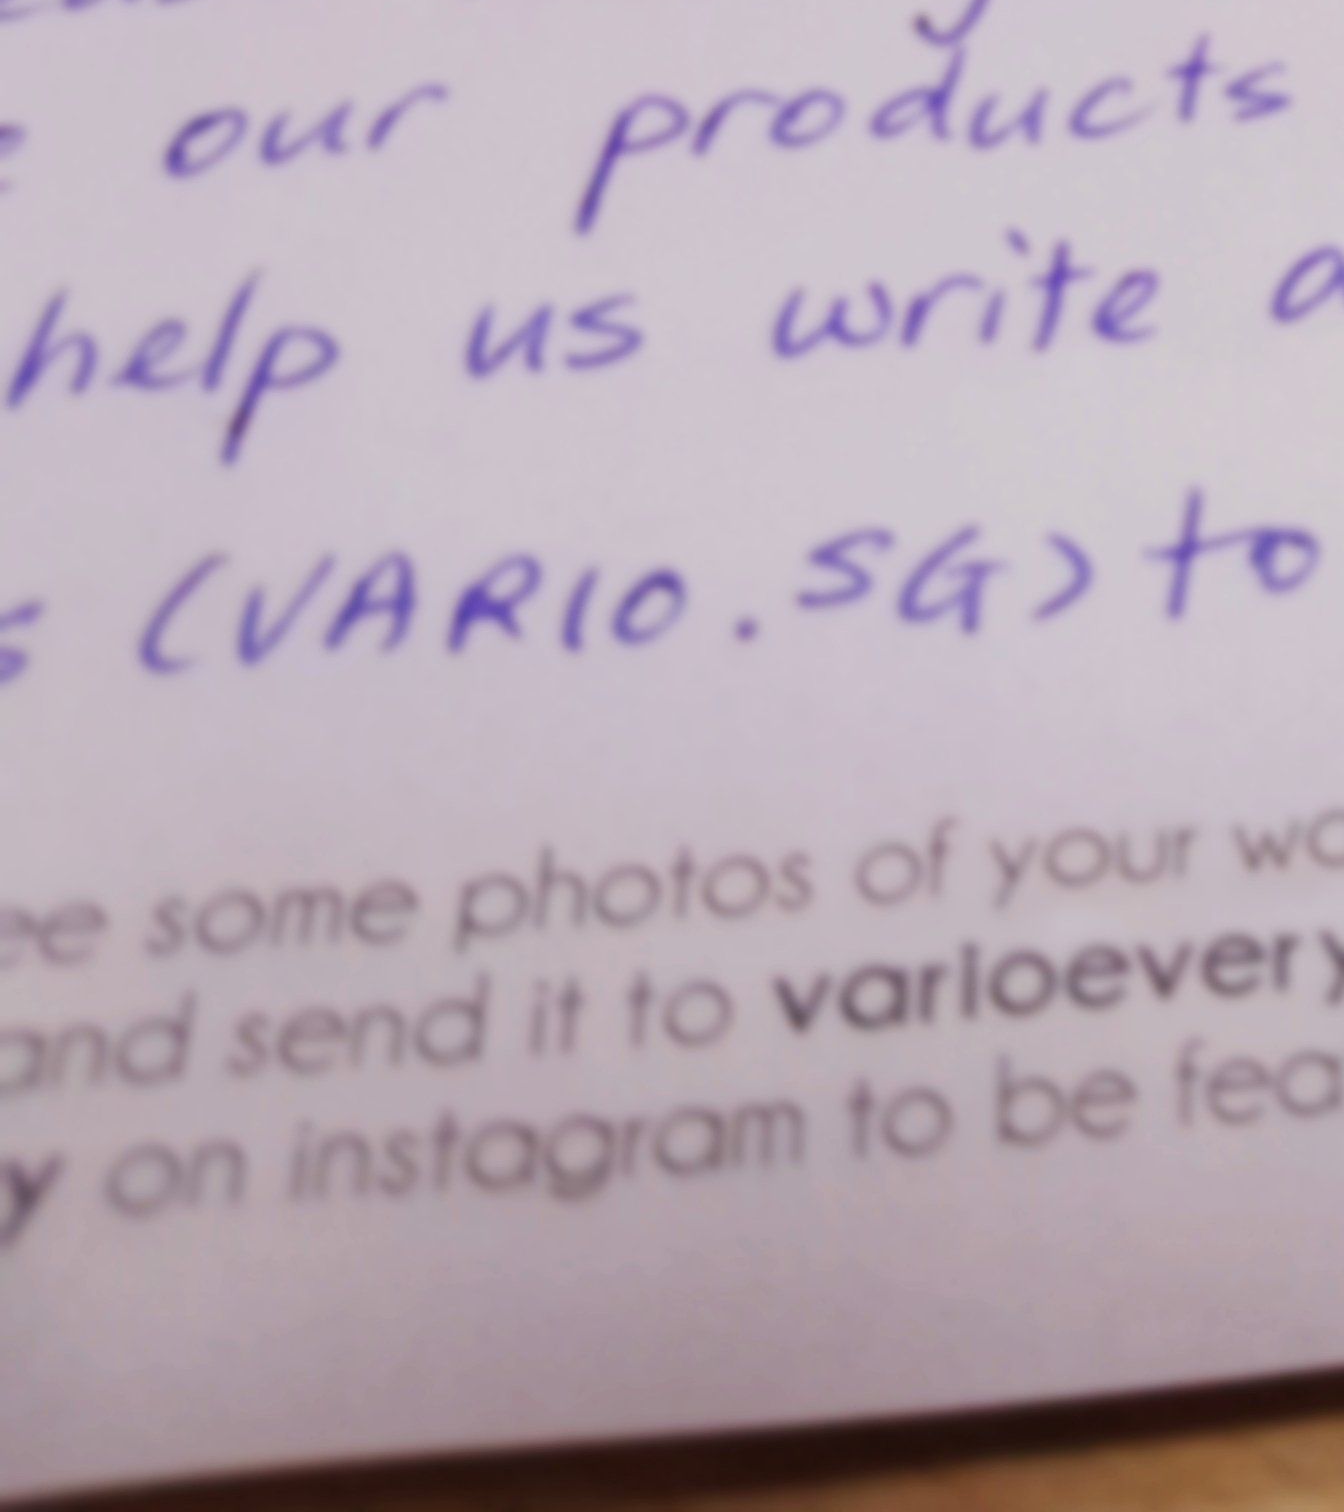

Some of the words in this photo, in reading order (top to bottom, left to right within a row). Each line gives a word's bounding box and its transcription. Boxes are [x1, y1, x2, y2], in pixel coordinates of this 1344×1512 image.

[163, 83, 448, 178] our
[5, 266, 340, 465] help
[465, 290, 645, 380] us
[770, 226, 1160, 358] write
[1145, 488, 1320, 620] to
[145, 883, 420, 958] some
[455, 846, 814, 953] photos
[855, 818, 956, 906] of
[990, 826, 1196, 910] your
[0, 990, 196, 1093] and
[225, 973, 492, 1080] send
[530, 978, 584, 1058] it
[630, 973, 735, 1050] to
[105, 1140, 248, 1220] on
[285, 1103, 803, 1202] instagram
[850, 1078, 955, 1158] to
[997, 1056, 1137, 1148] be
